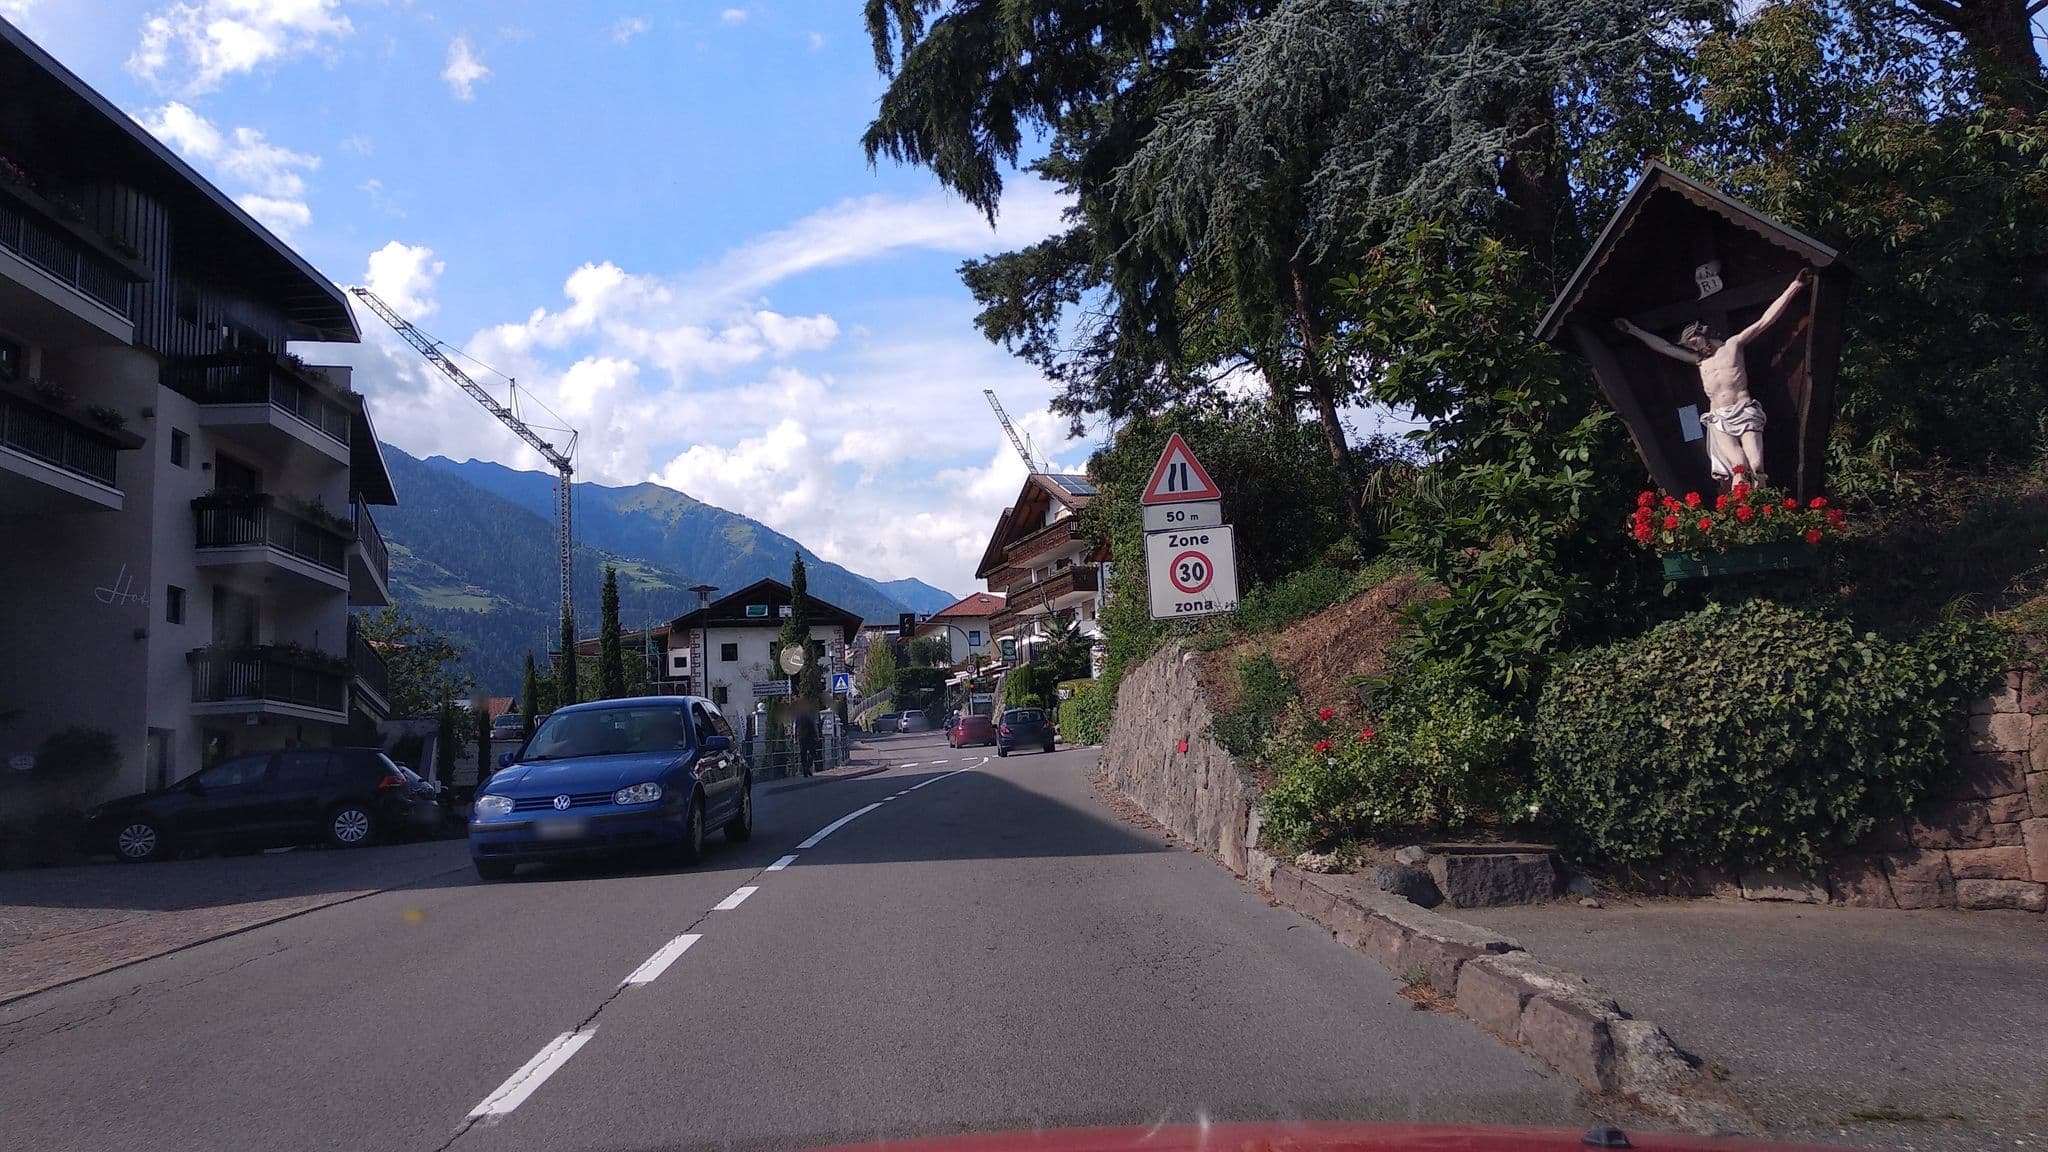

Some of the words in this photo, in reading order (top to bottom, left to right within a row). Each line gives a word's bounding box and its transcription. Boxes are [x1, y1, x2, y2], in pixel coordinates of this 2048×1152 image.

[1166, 511, 1185, 523] 50
[1190, 513, 1199, 521] m
[1168, 534, 1210, 548] Zone
[1179, 562, 1205, 582] 30
[1175, 600, 1213, 613] zona
